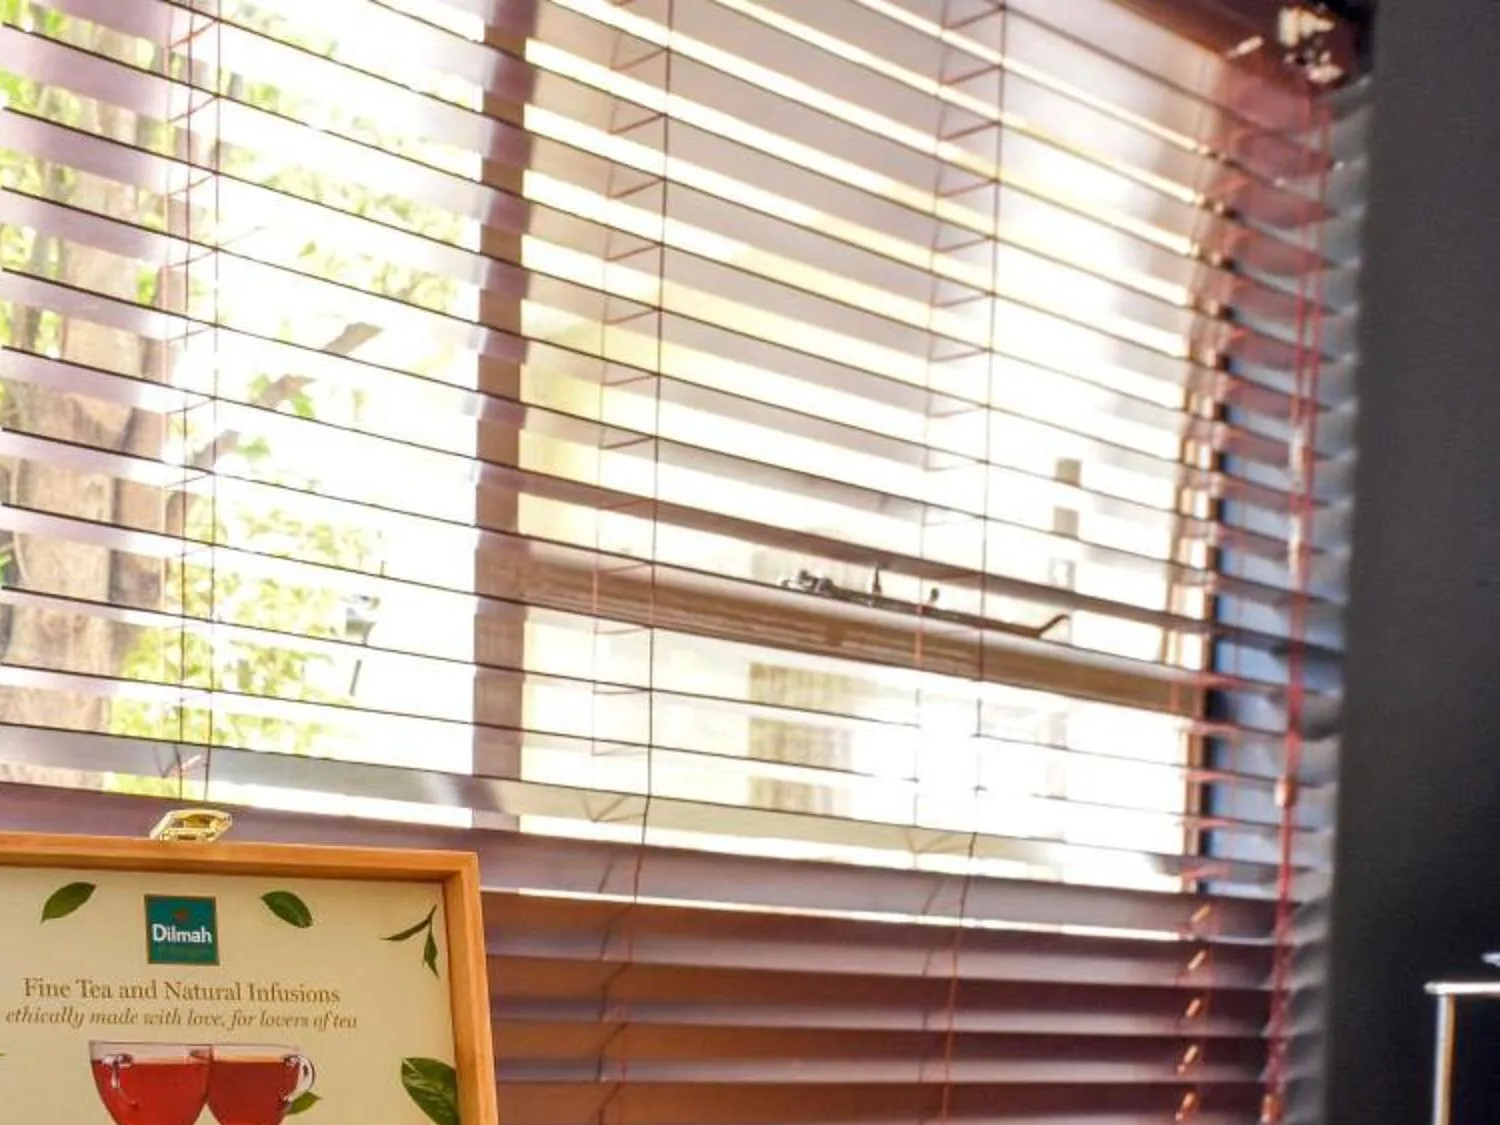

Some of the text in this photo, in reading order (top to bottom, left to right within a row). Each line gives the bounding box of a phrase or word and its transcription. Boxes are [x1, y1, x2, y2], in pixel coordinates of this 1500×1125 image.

[151, 922, 213, 944] Dilmah
[23, 976, 341, 1003] Fine Tea and Natural Infusions
[5, 1005, 85, 1030] ethically
[89, 1007, 139, 1025] made
[144, 1008, 182, 1026] with
[227, 1009, 257, 1032] for
[259, 1010, 309, 1028] lovers
